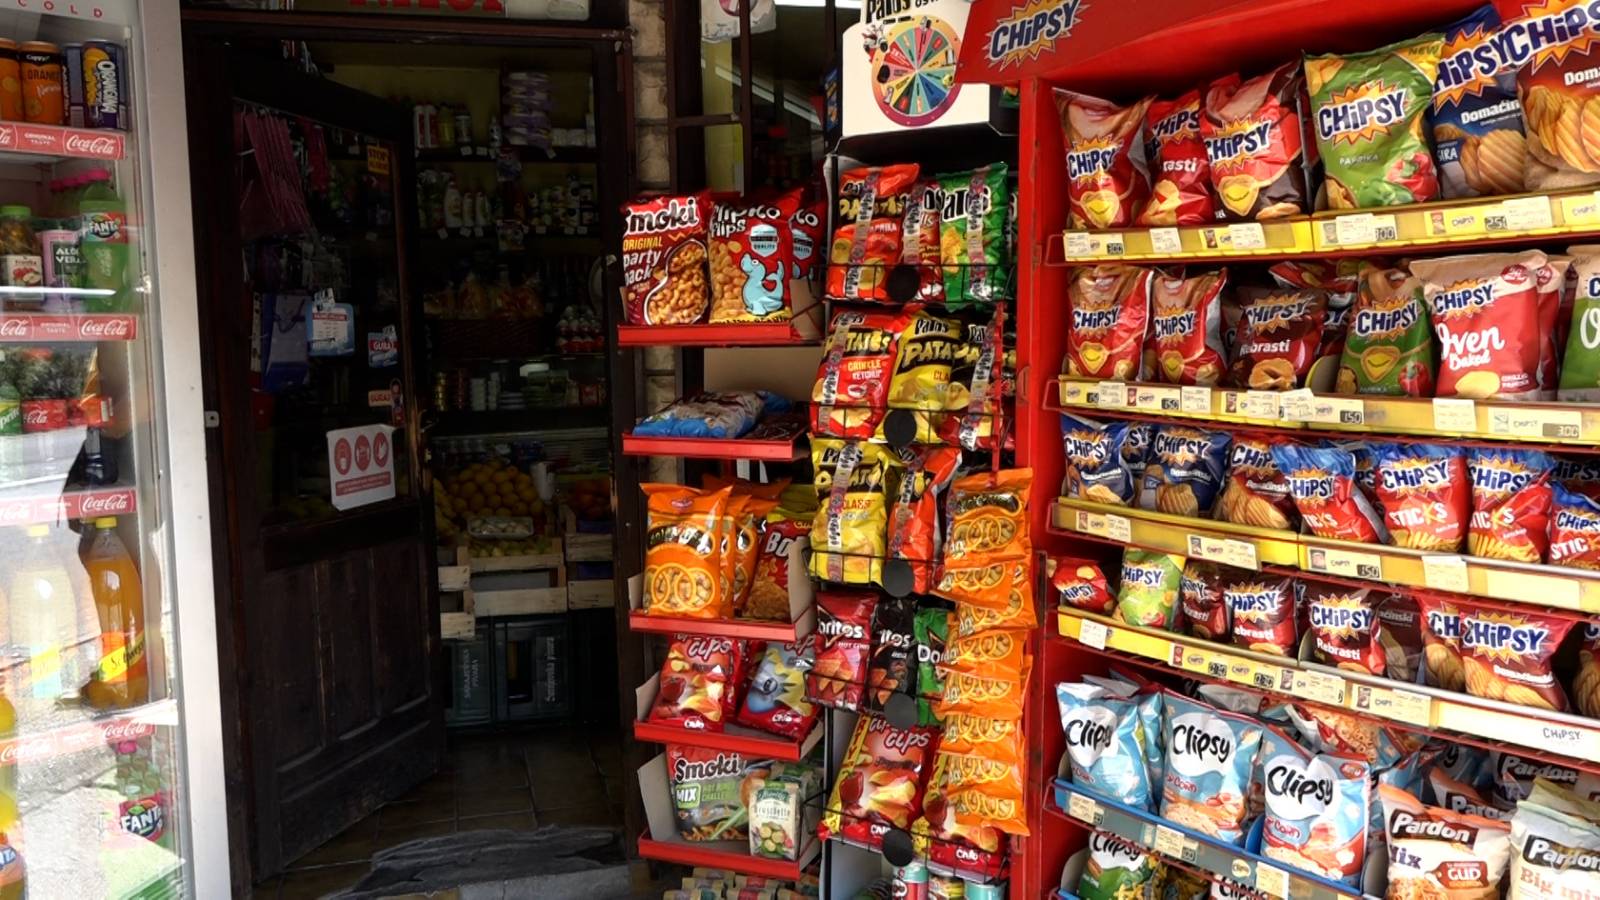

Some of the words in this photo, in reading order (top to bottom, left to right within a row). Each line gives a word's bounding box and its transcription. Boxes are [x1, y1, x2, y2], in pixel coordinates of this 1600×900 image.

[1408, 44, 1441, 56] NEW
[1162, 157, 1198, 173] rasti
[622, 236, 664, 251] ORIGINAL
[1448, 349, 1492, 370] Baked
[1389, 500, 1448, 529] STICKS
[818, 620, 863, 639] oritos
[1172, 723, 1230, 763] Clipsy
[675, 753, 742, 783] Smoki
[676, 788, 699, 803] MIX
[1268, 765, 1334, 806] Clipsy
[1391, 811, 1470, 843] Pardon
